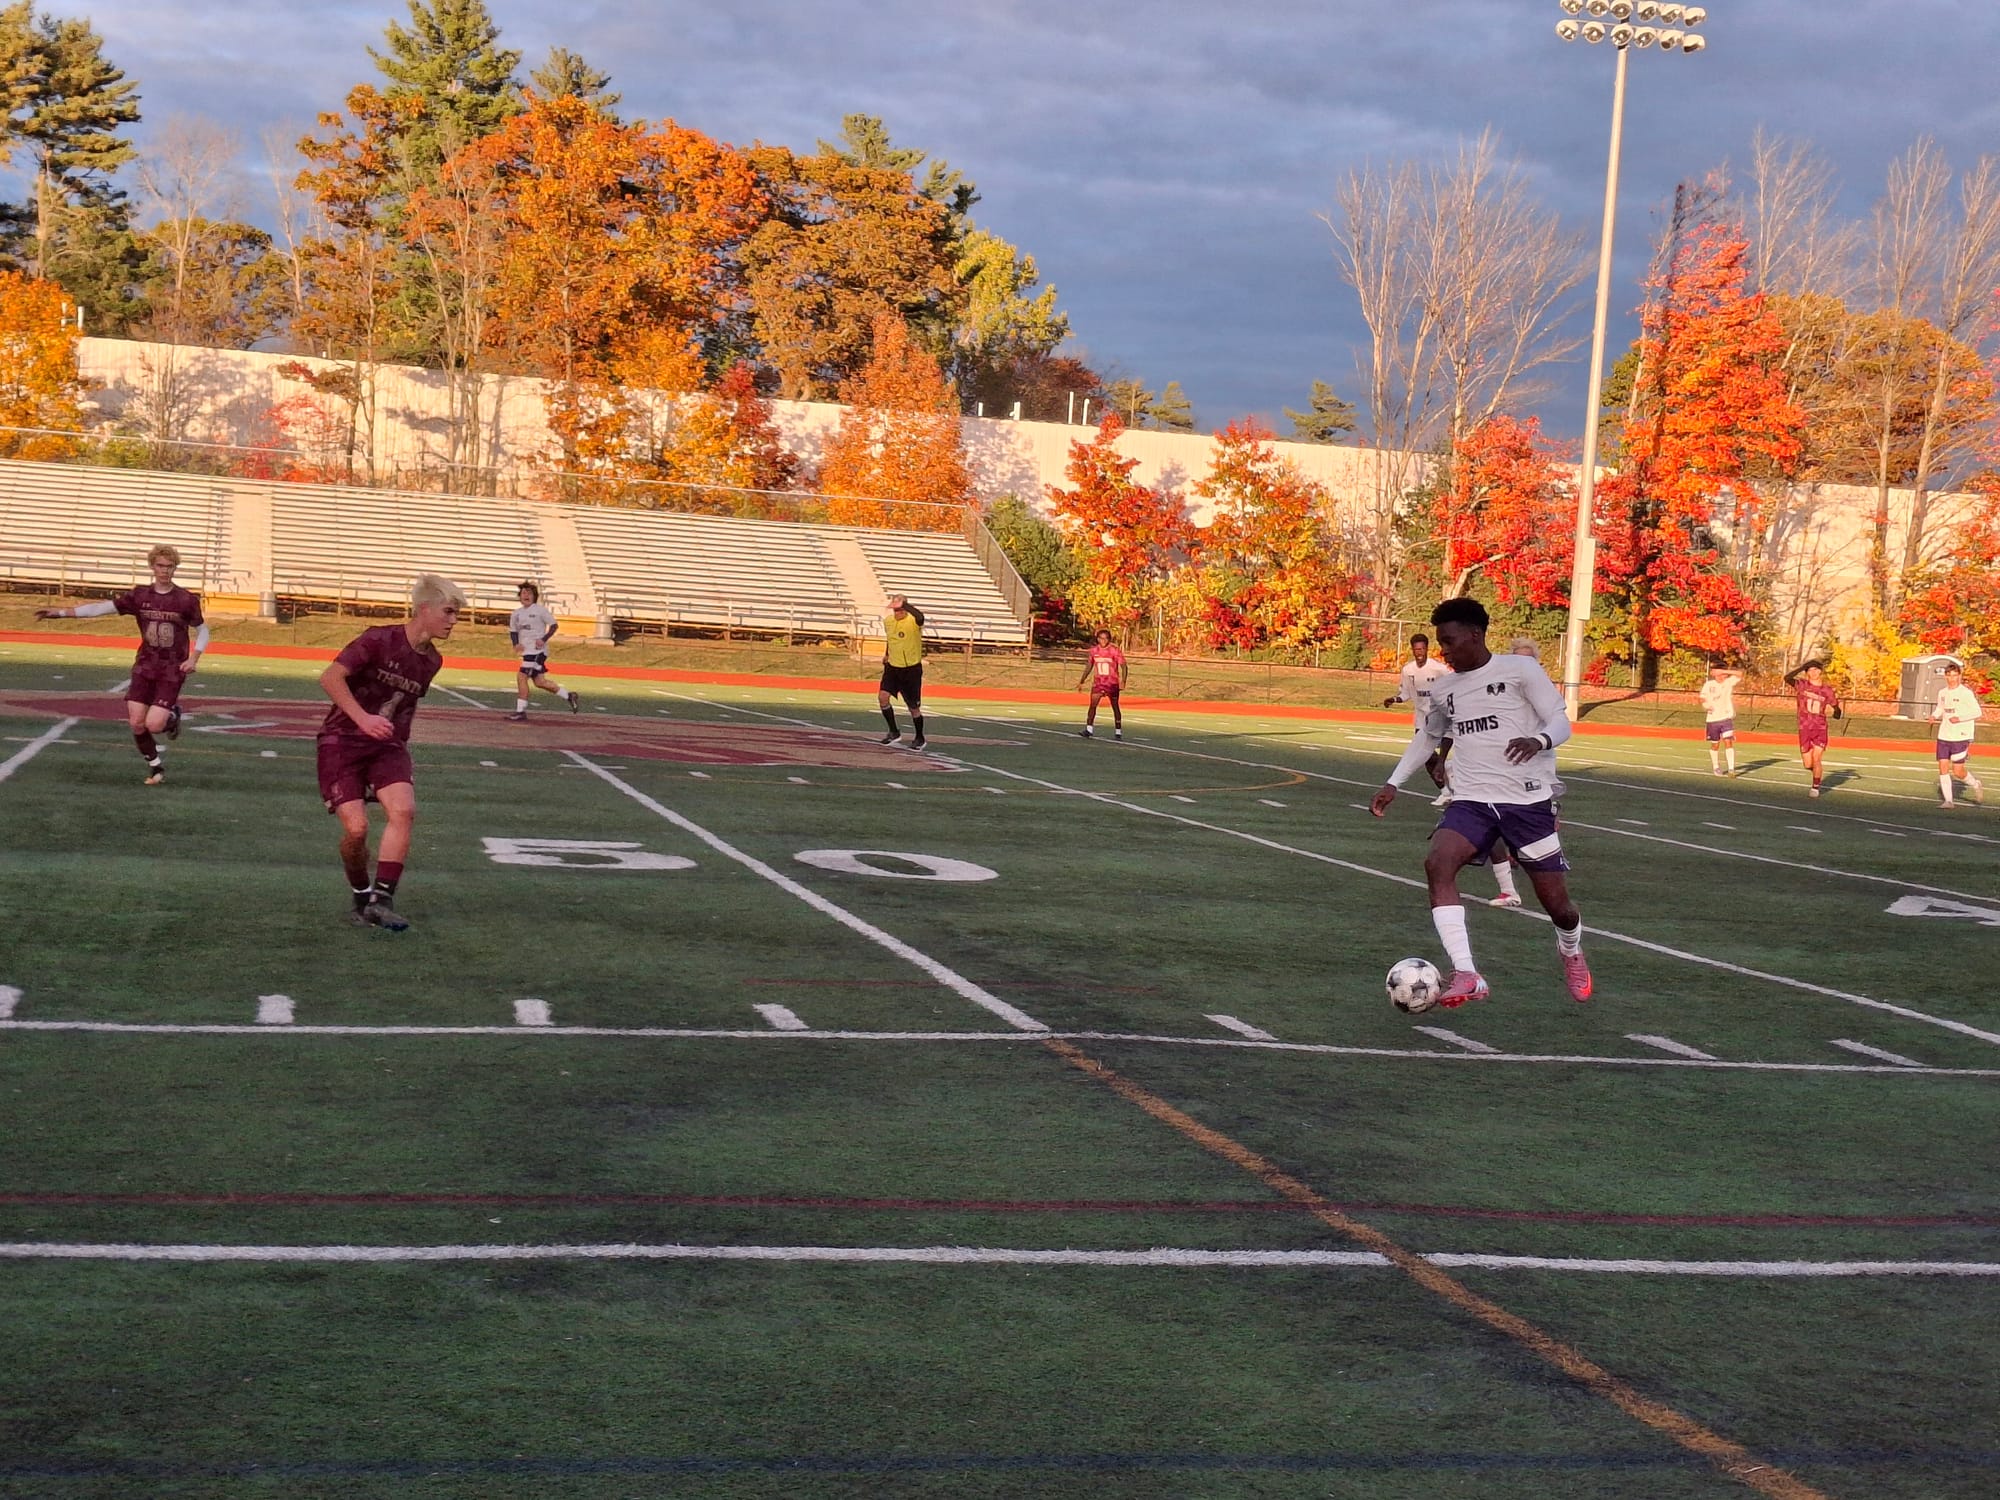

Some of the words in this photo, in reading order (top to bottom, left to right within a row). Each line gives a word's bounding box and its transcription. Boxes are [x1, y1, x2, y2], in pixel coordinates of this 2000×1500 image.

[1457, 715, 1498, 736] RAMS
[481, 837, 697, 869] 5
[793, 850, 998, 881] 0
